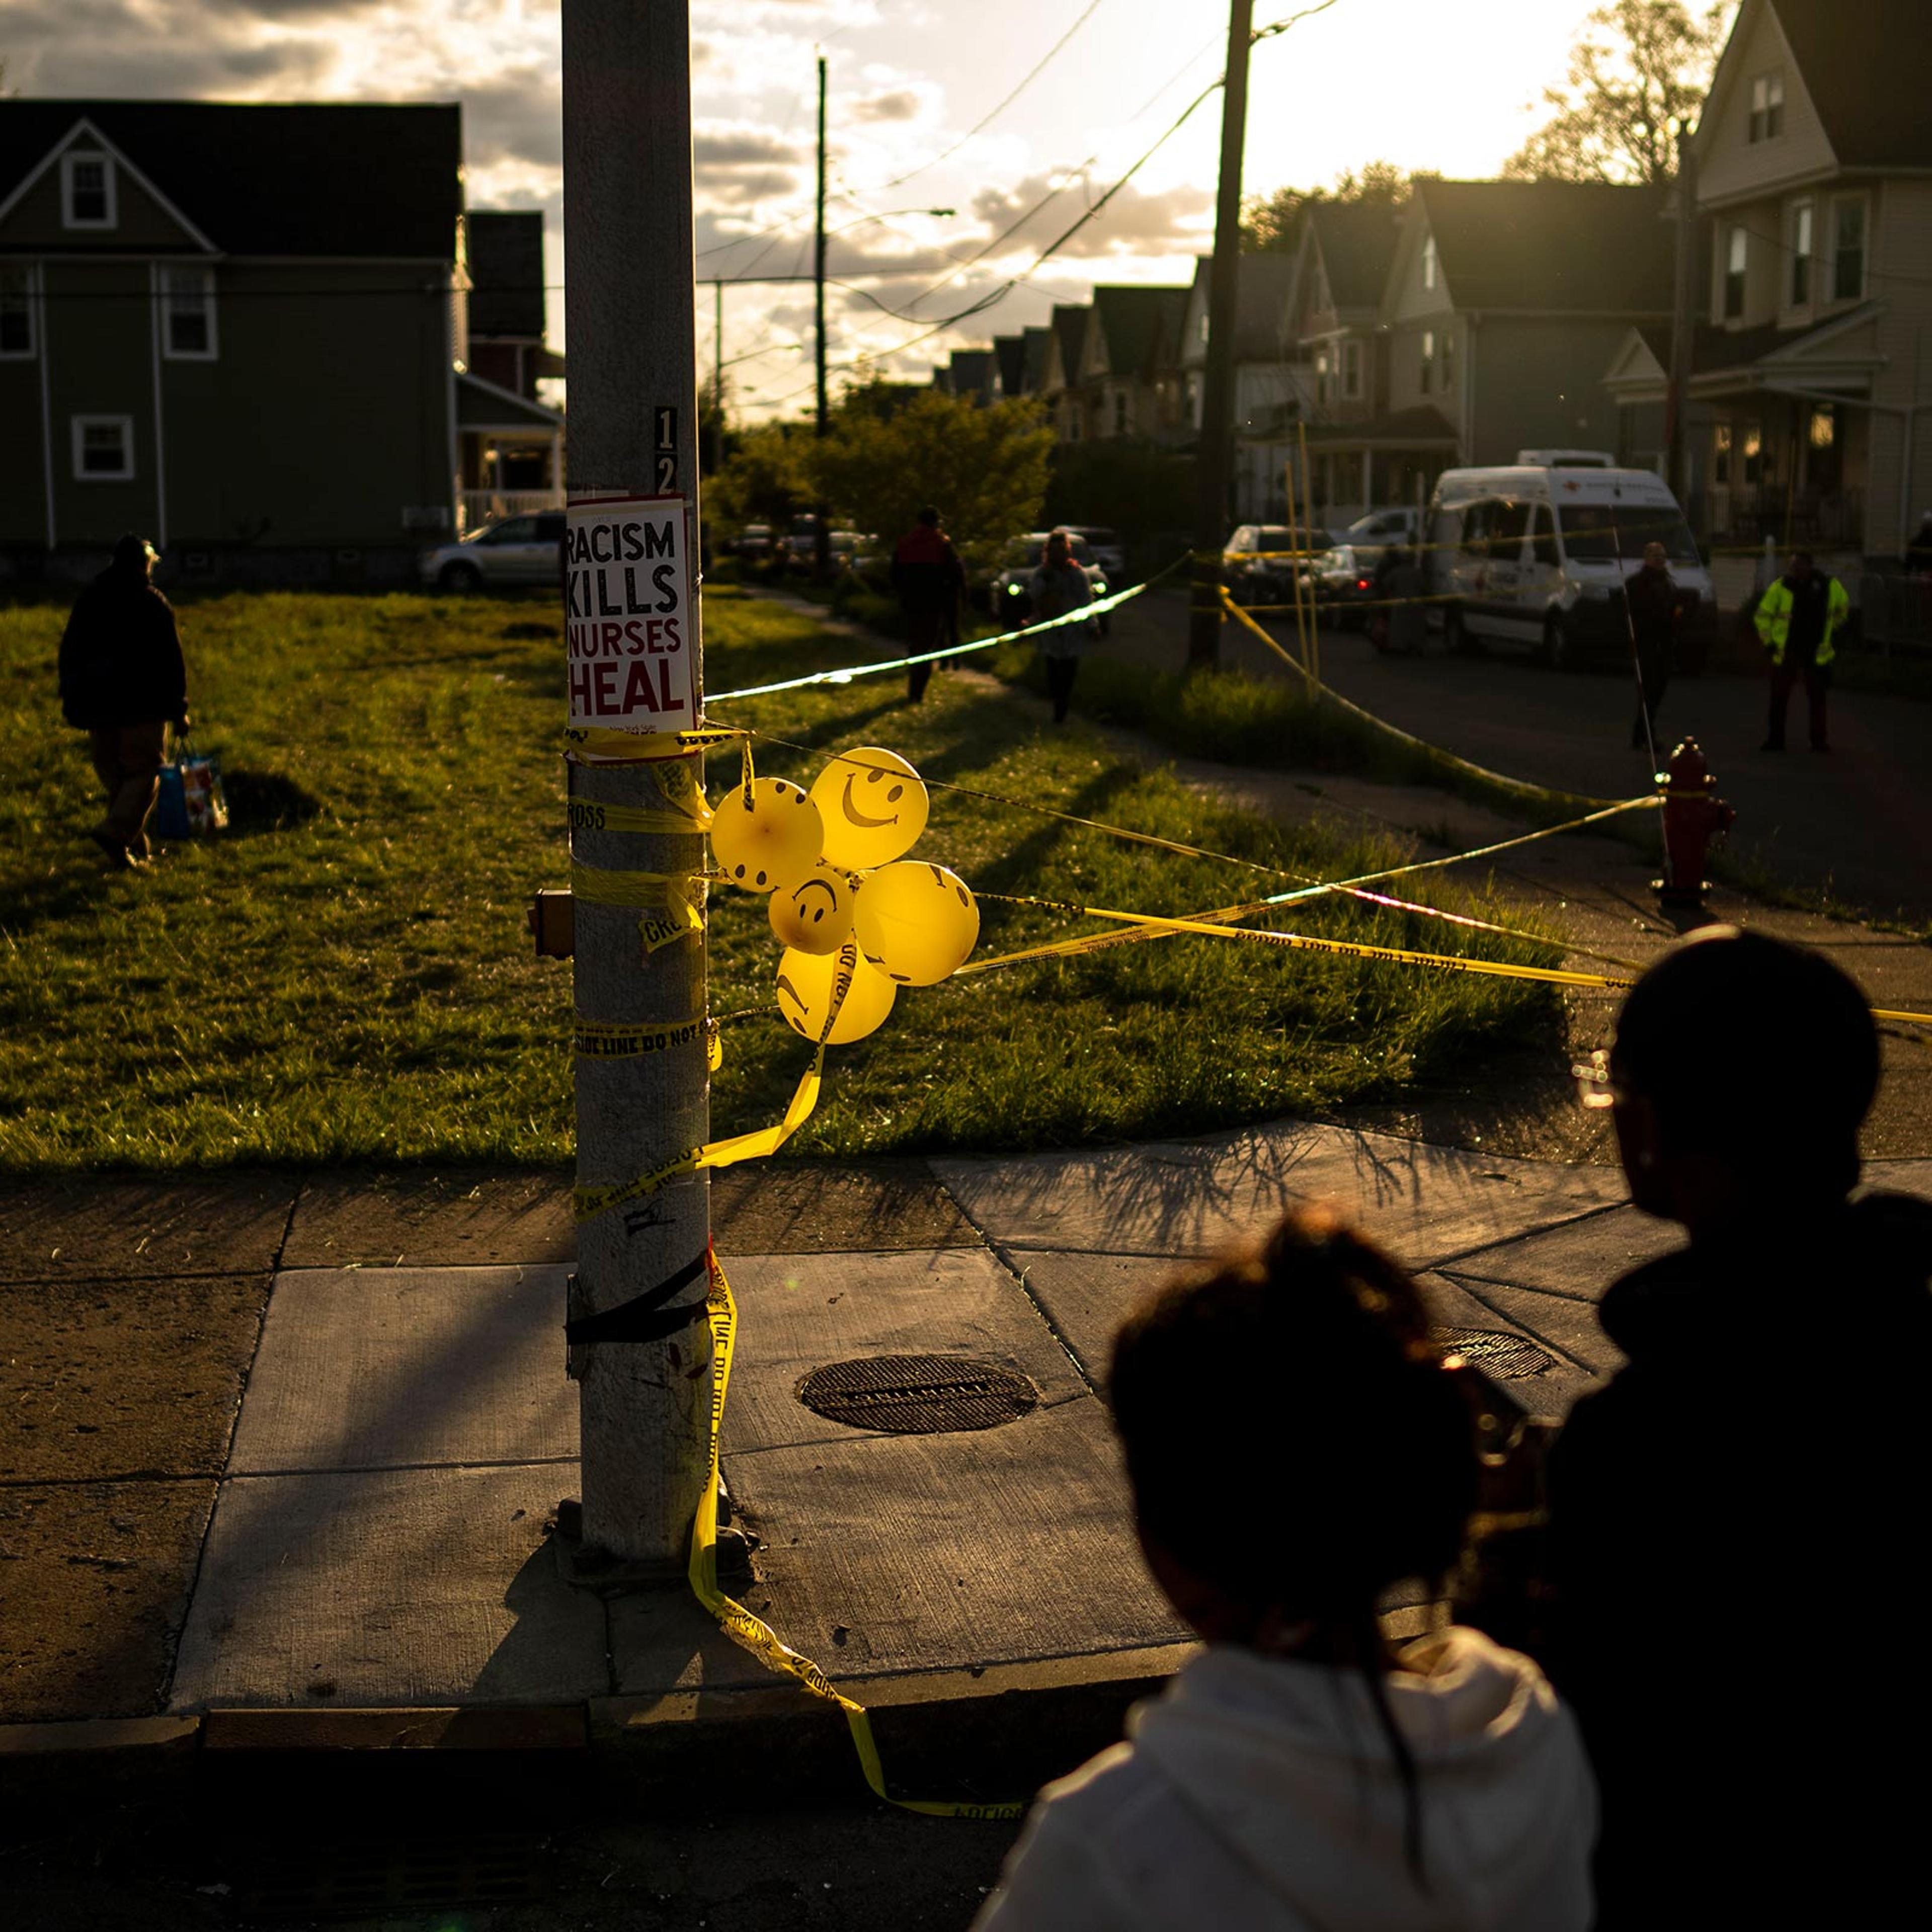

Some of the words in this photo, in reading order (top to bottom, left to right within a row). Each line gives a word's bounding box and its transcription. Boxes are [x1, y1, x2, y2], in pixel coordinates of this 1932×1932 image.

[567, 521, 675, 564] RACISM
[568, 565, 678, 618] KILLS
[569, 618, 681, 658] NURSES
[570, 659, 684, 716] HEAL
[604, 1037, 638, 1055] LINE
[642, 1033, 666, 1052] DO
[670, 1024, 696, 1047] NOT
